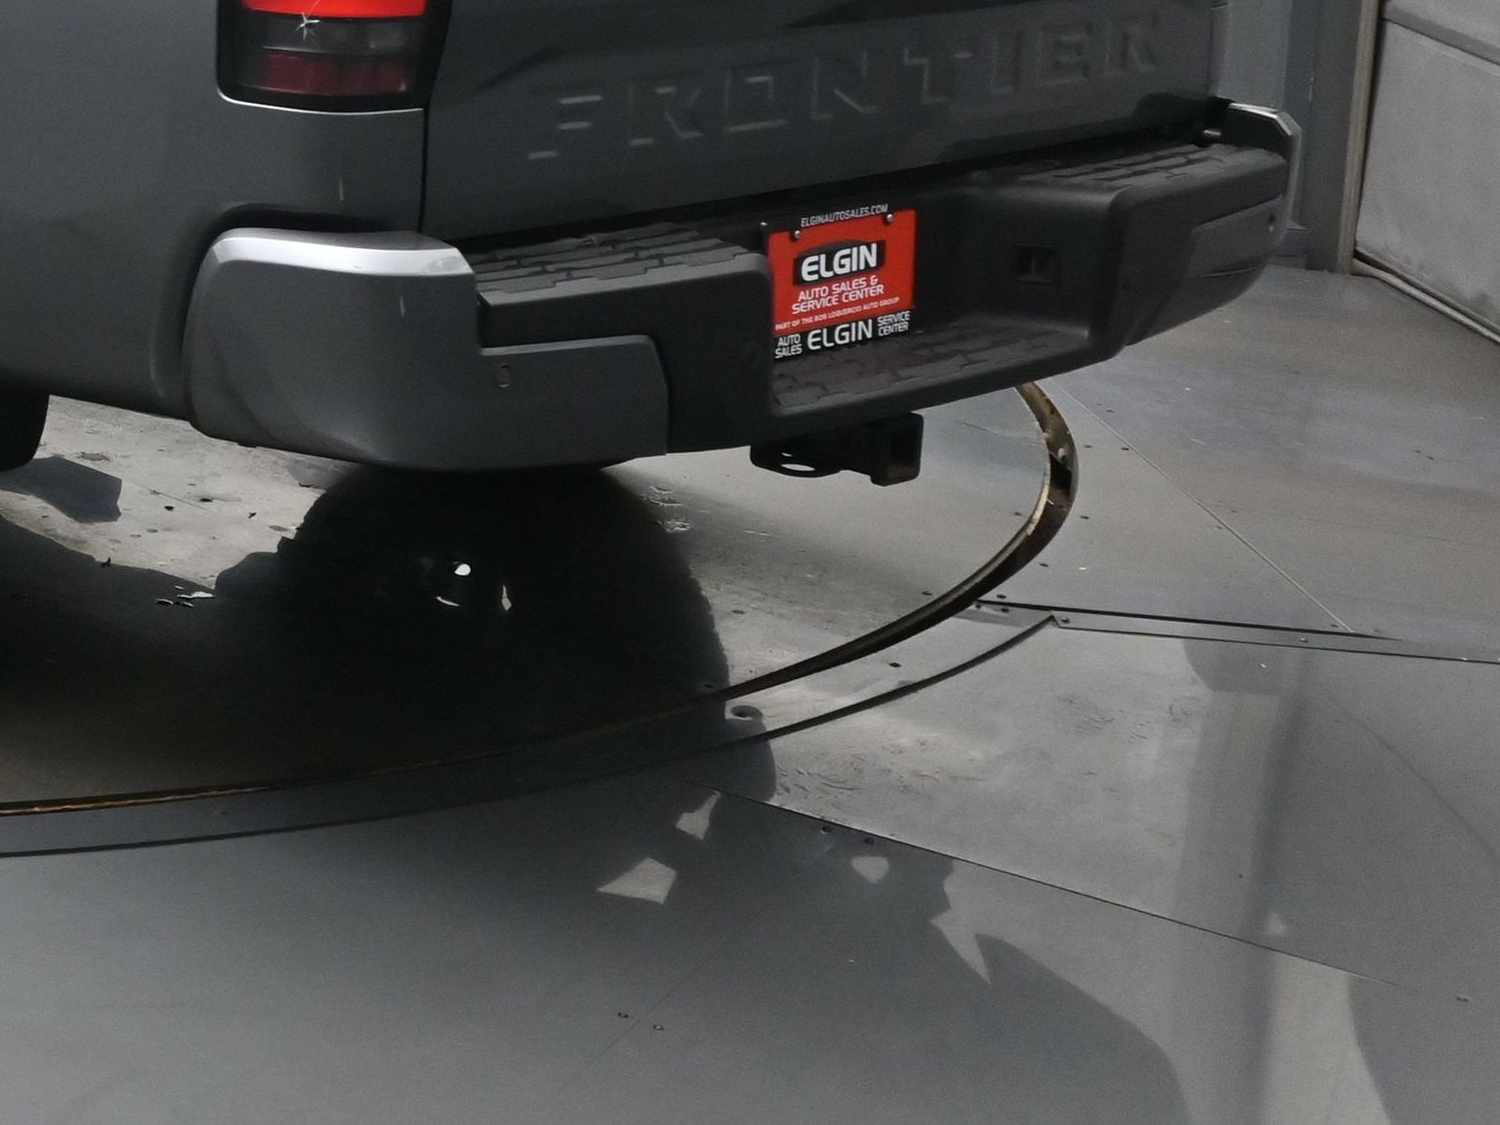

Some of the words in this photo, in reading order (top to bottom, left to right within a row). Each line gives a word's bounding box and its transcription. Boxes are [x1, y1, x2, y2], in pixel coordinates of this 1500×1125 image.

[529, 14, 1160, 161] FRONTIER
[801, 203, 888, 227] ELGINAUTOSALES.COM
[801, 243, 877, 281] ELGIN
[791, 295, 840, 315] SERVICE
[842, 284, 884, 303] CENTER
[798, 285, 829, 302] AUTO
[831, 277, 867, 294] SALES
[870, 274, 879, 286] &
[775, 322, 791, 331] PART
[791, 319, 800, 327] OF
[876, 310, 911, 327] SERVICE
[877, 321, 909, 337] CENTER
[777, 333, 801, 348] AUTO
[807, 319, 873, 351] ELGIN
[774, 343, 803, 360] SALES
